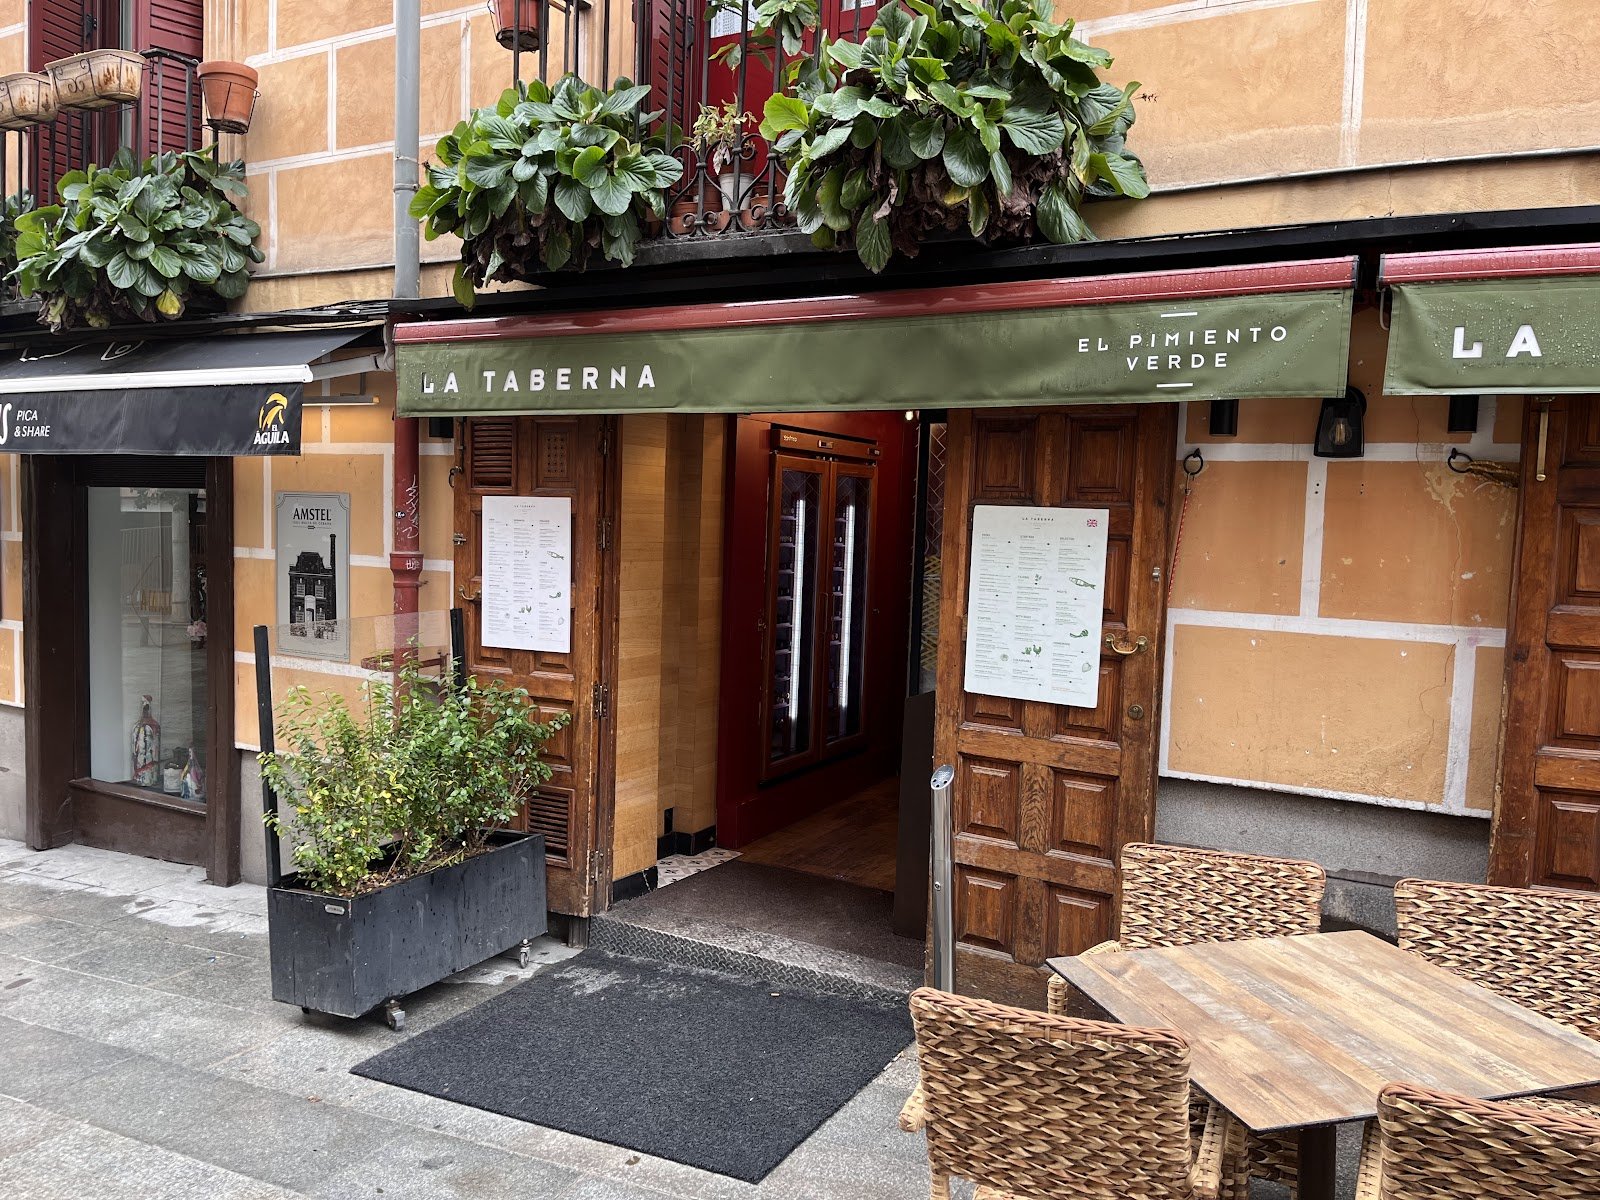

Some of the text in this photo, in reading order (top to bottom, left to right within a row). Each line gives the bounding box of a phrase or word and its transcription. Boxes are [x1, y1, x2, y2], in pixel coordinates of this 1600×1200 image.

[1078, 325, 1287, 353] EL PIMIENTO
[1452, 324, 1543, 359] LA
[1126, 352, 1228, 371] VERDE
[421, 364, 656, 394] LA TABERNA
[16, 409, 38, 421] PICA
[253, 430, 290, 445] ÁGUILA
[293, 508, 332, 521] AMSTEL
